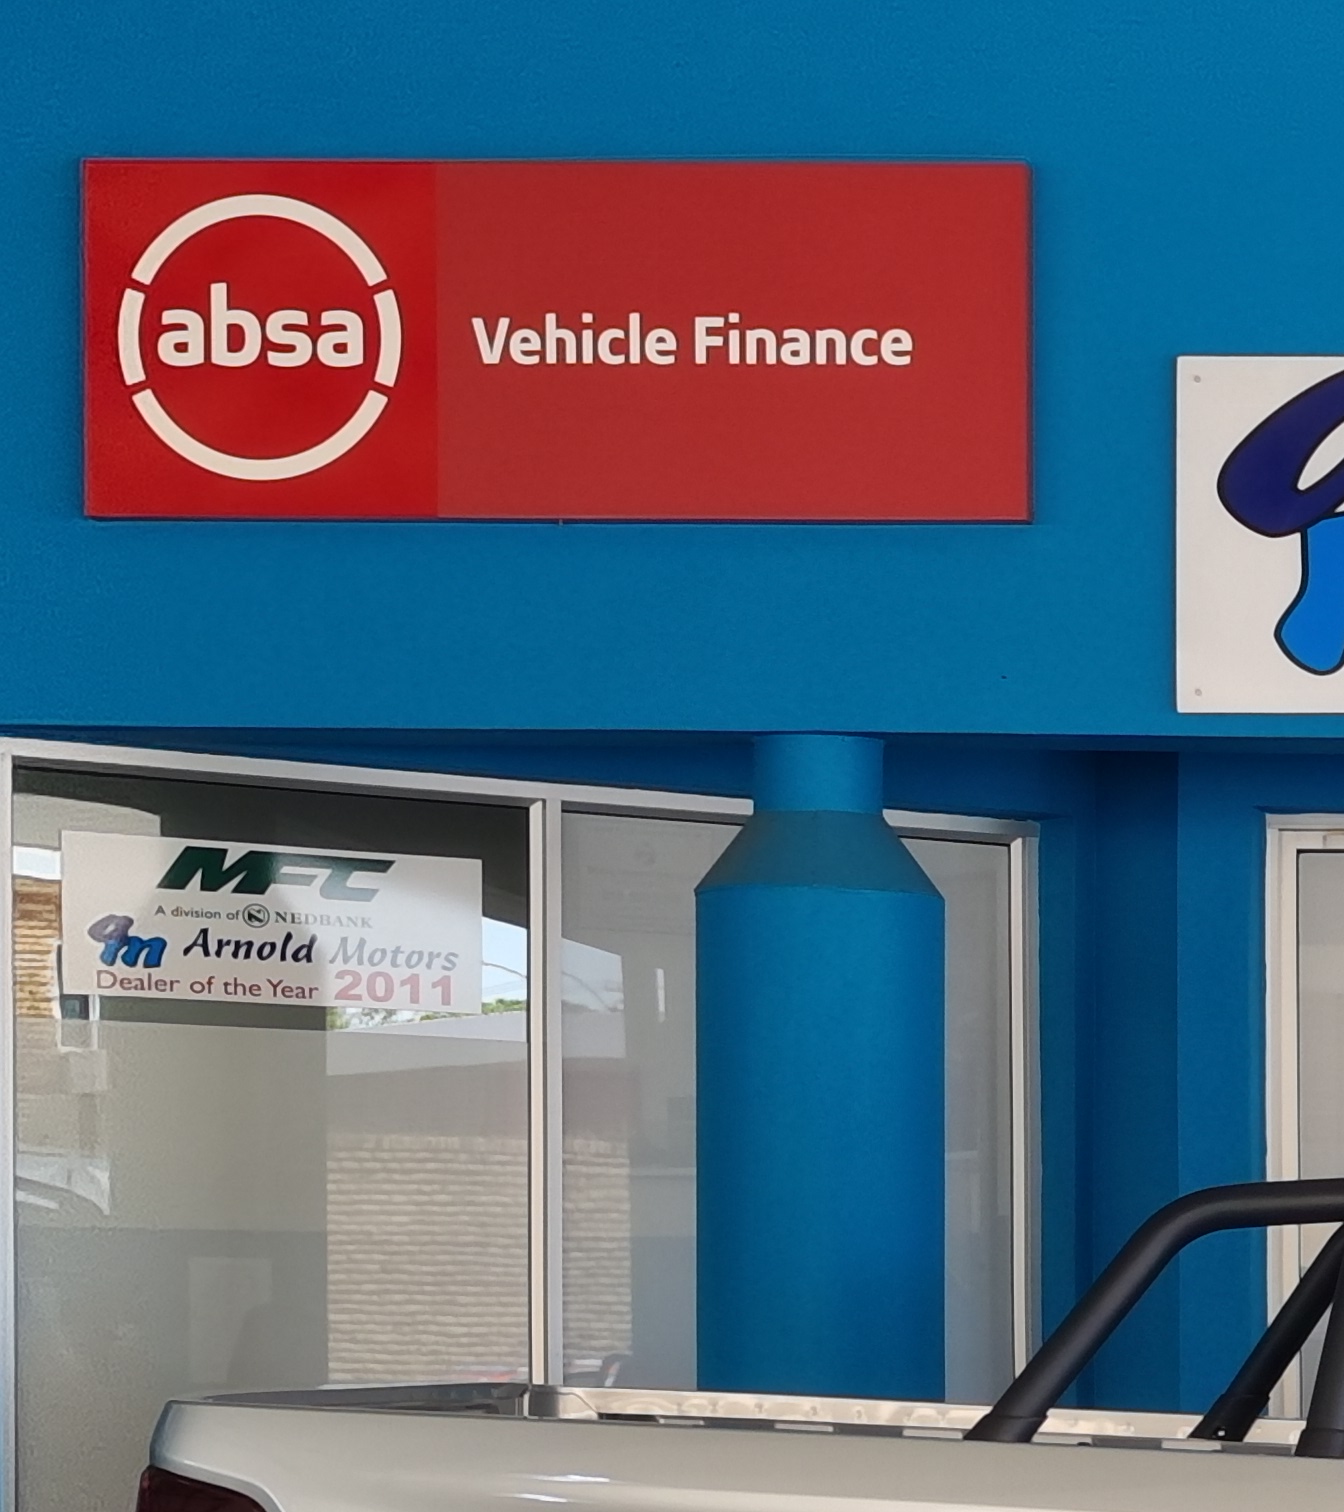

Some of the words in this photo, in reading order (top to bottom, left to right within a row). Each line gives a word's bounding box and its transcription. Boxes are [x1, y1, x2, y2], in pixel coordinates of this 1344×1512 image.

[157, 281, 364, 367] absa
[472, 313, 678, 366] Vehicle
[694, 313, 913, 366] Finance
[156, 844, 397, 902] MFC
[154, 905, 167, 918] A
[170, 905, 221, 921] division
[226, 908, 241, 921] of
[274, 910, 374, 930] NEDBANK
[182, 927, 319, 965] Arnold
[328, 935, 460, 973] Motors
[95, 968, 181, 993] Dealer
[189, 975, 216, 995] of
[223, 975, 263, 998] the
[266, 977, 320, 1001] Year
[333, 968, 454, 1007] 2011
